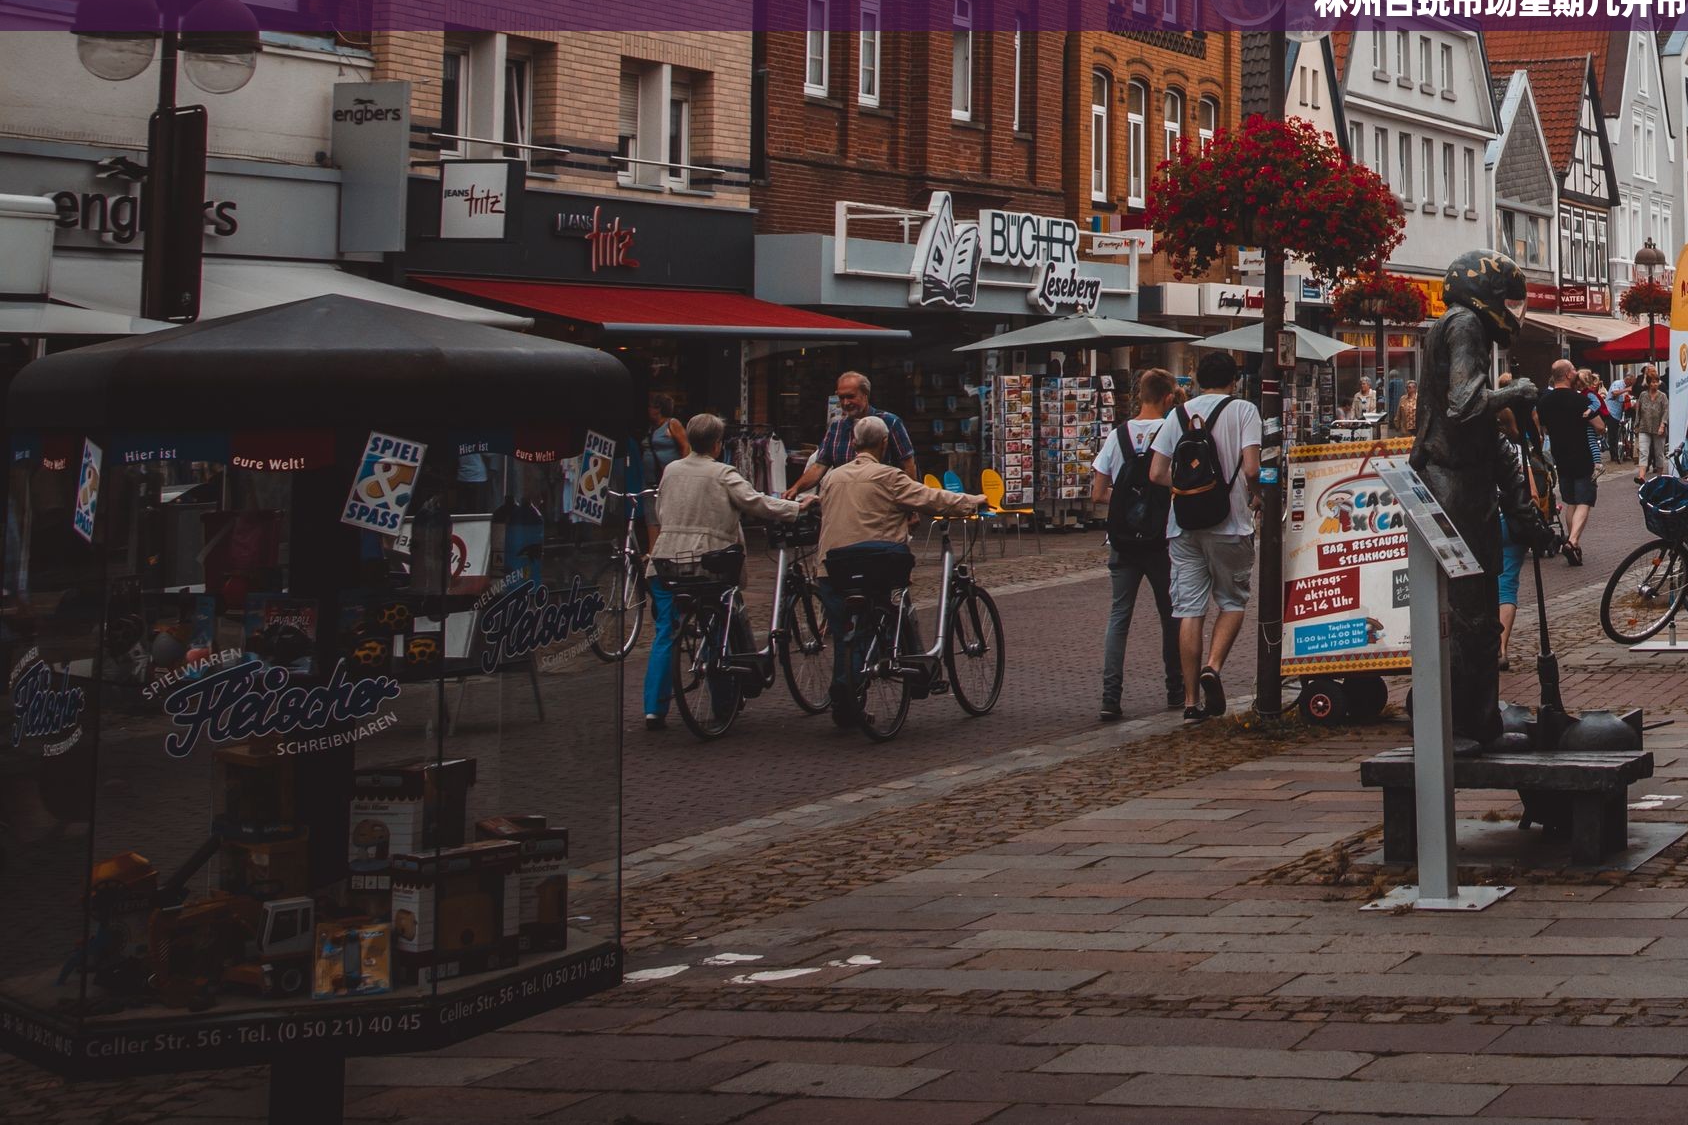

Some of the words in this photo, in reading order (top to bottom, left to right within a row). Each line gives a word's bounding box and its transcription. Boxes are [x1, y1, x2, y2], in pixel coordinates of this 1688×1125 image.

[333, 104, 402, 125] engbers
[443, 189, 469, 198] JEANS
[464, 184, 505, 217] fritz
[990, 211, 1078, 264] BÜCHER
[1038, 261, 1101, 309] Leseberg
[125, 450, 153, 463] Hier
[159, 447, 178, 459] ist
[232, 455, 264, 470] eure
[269, 456, 305, 470] Welt!
[368, 435, 420, 463] SPIEL
[344, 501, 401, 531] SPASS
[1317, 509, 1408, 535] MEXICA
[1322, 543, 1347, 557] BAR,
[1338, 546, 1407, 566] STEAKHOUSE
[1295, 574, 1348, 591] Mittags-
[1304, 587, 1341, 601] aktion
[1294, 601, 1328, 616] 12-14
[1331, 596, 1354, 608] Uhr
[141, 647, 244, 701] SPIELWAREN
[276, 710, 400, 757] SCHREIBWAREN
[439, 1002, 474, 1025] Celler
[500, 988, 514, 1006] 56
[521, 980, 540, 998] Tel.
[86, 1036, 148, 1058] Celler
[154, 1033, 191, 1051] Str.
[196, 1028, 222, 1047] 56
[238, 1024, 271, 1043] Tel.
[303, 1021, 326, 1038] 50
[332, 1016, 363, 1037] 21)
[368, 1015, 392, 1033] 40
[397, 1013, 422, 1031] 45
